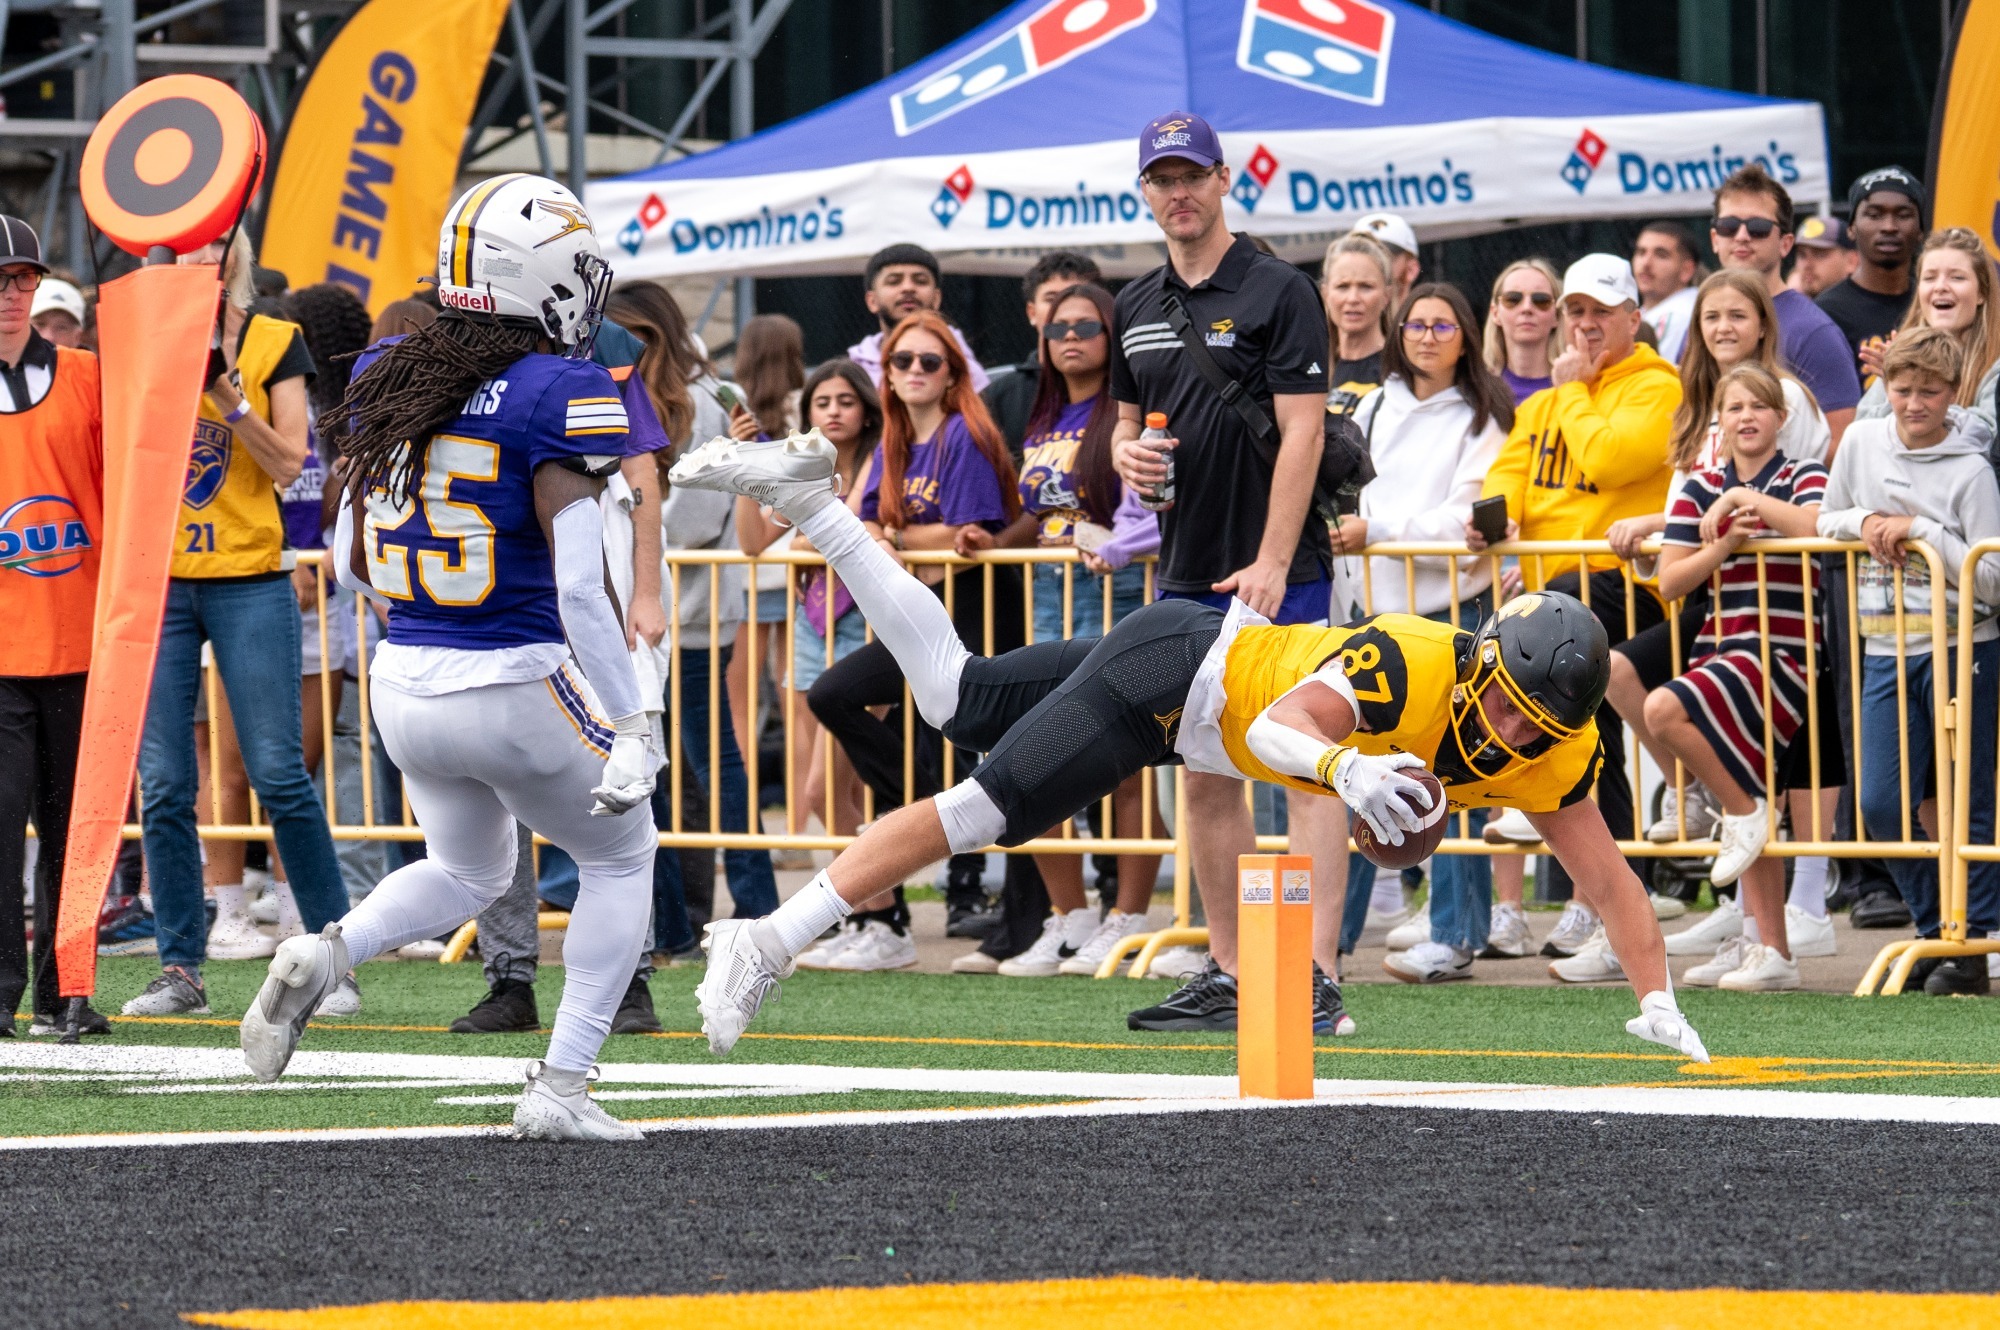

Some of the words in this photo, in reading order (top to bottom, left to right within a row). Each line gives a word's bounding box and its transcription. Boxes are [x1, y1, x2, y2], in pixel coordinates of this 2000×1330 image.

[332, 50, 417, 261] GAME
[1289, 157, 1475, 213] Domino's
[670, 196, 844, 254] Domino's
[461, 380, 508, 415] GS
[0, 521, 92, 559] OUA
[184, 523, 215, 552] 21
[363, 434, 500, 606] 25
[1341, 643, 1393, 703] 87
[1532, 697, 1560, 722] WATERLOO
